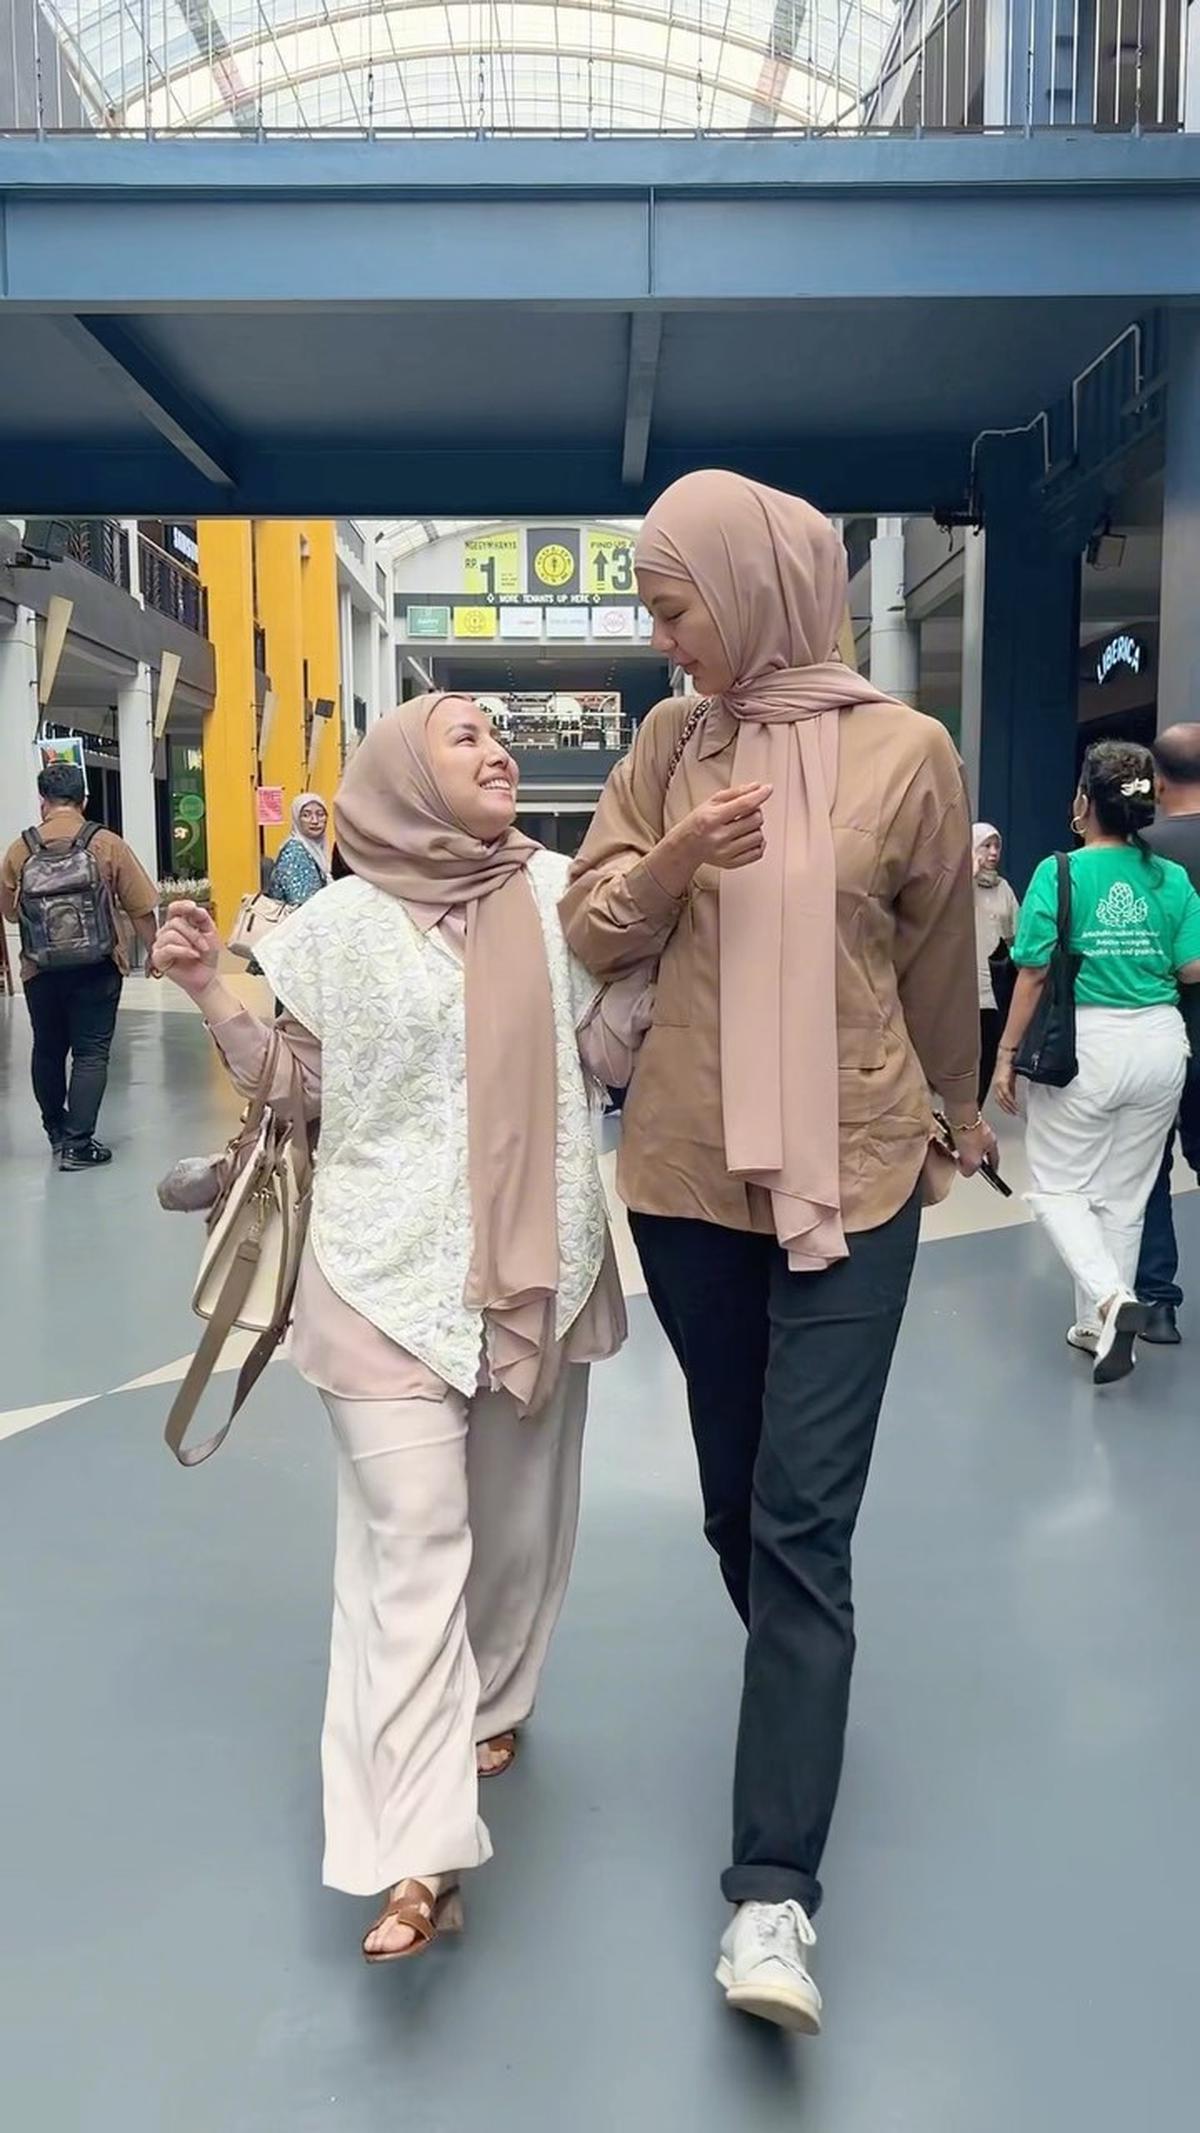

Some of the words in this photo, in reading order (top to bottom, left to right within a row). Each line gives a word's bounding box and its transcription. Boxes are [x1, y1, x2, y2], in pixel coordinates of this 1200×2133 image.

[590, 541, 611, 549] FIND
[499, 594, 519, 604] MORE
[523, 594, 554, 604] TENANTS
[556, 594, 568, 604] UP
[571, 594, 590, 604] HERE
[1097, 635, 1140, 685] LIBERICA
